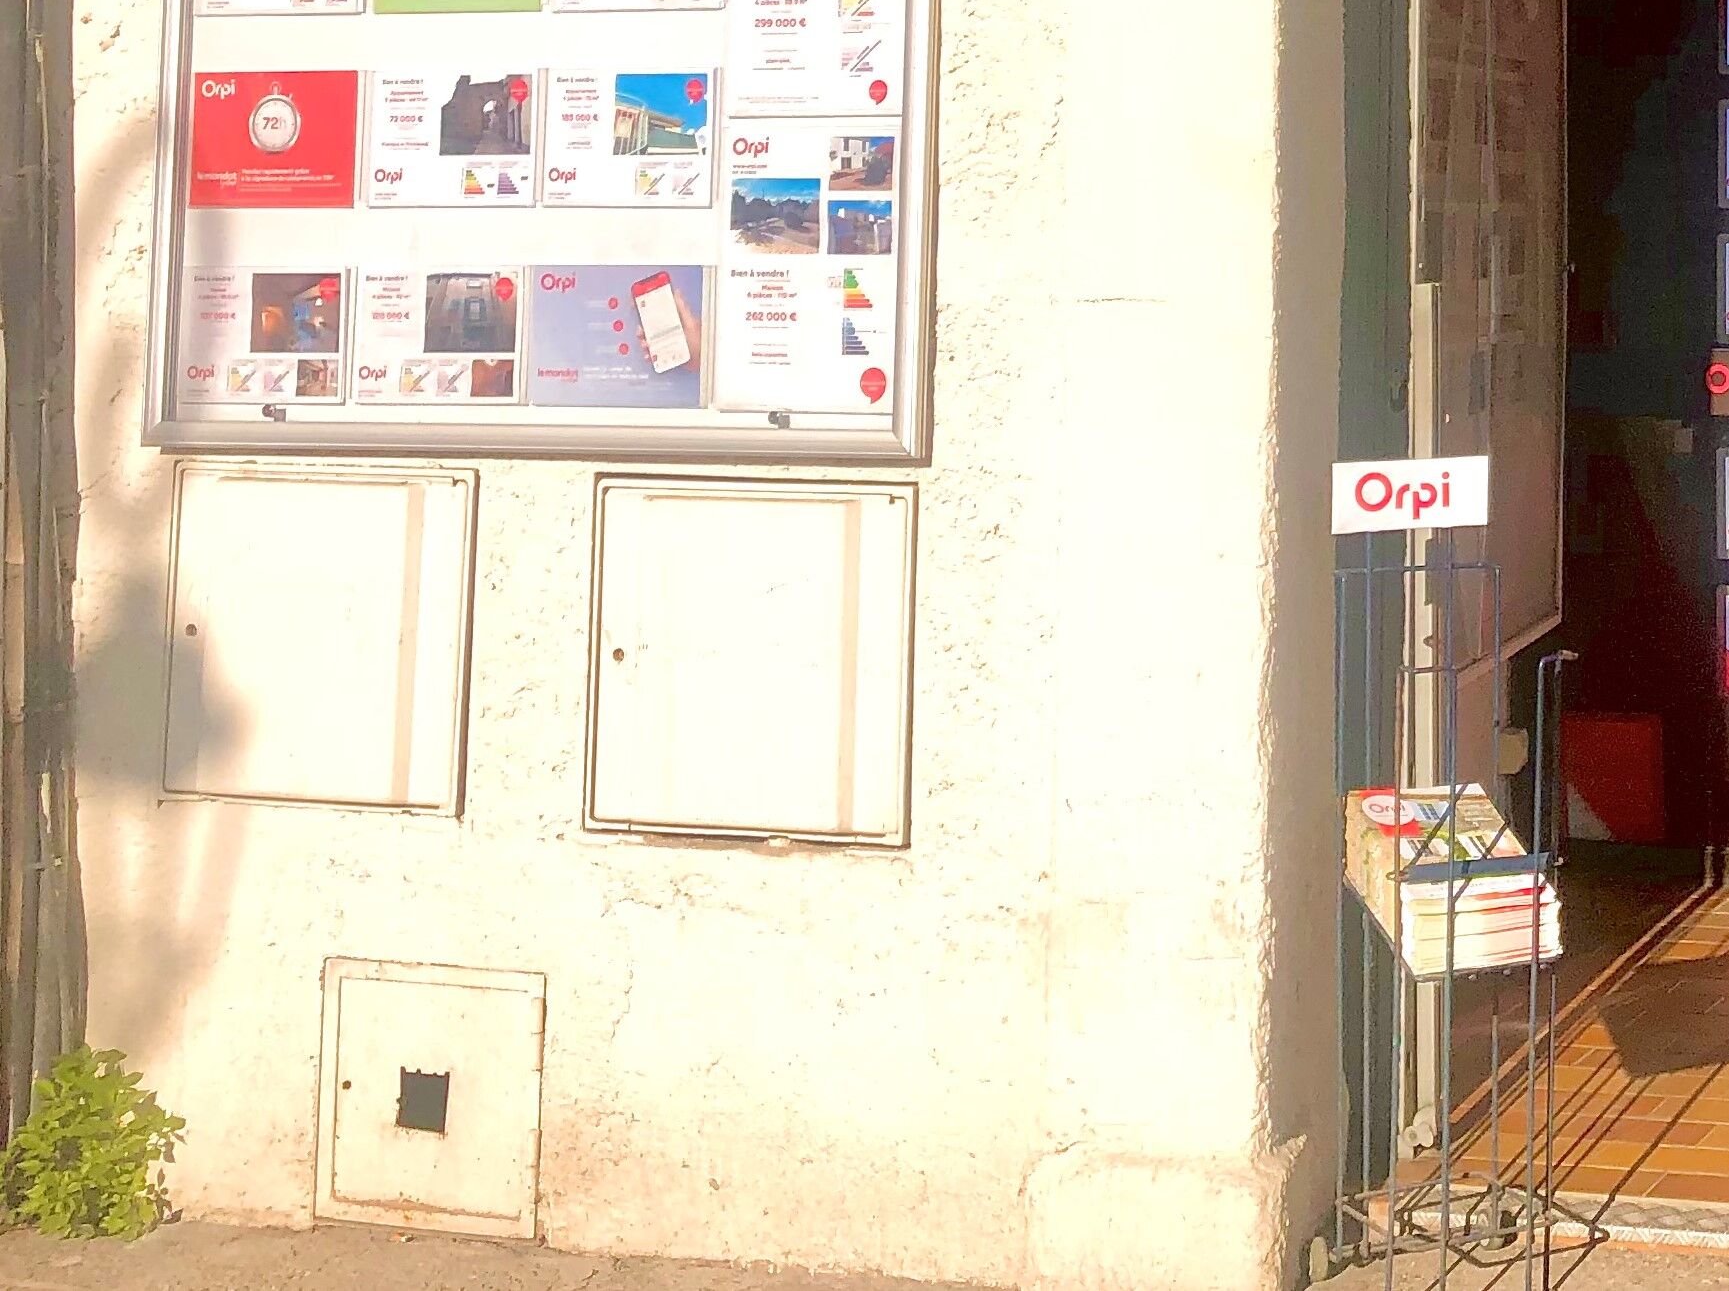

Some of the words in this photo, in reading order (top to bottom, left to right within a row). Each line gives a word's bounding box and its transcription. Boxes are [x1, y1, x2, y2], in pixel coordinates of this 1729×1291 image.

[775, 18, 797, 27] 000
[799, 17, 807, 27] €
[201, 78, 236, 100] Orpi
[732, 136, 770, 158] Orpi
[374, 167, 403, 184] Orpi
[549, 167, 577, 184] Orpi
[540, 272, 576, 293] Orpi
[766, 312, 787, 321] 000
[789, 312, 797, 321] €
[187, 364, 215, 382] Orpi
[358, 365, 387, 382] Orpi
[1354, 471, 1451, 520] Orpi
